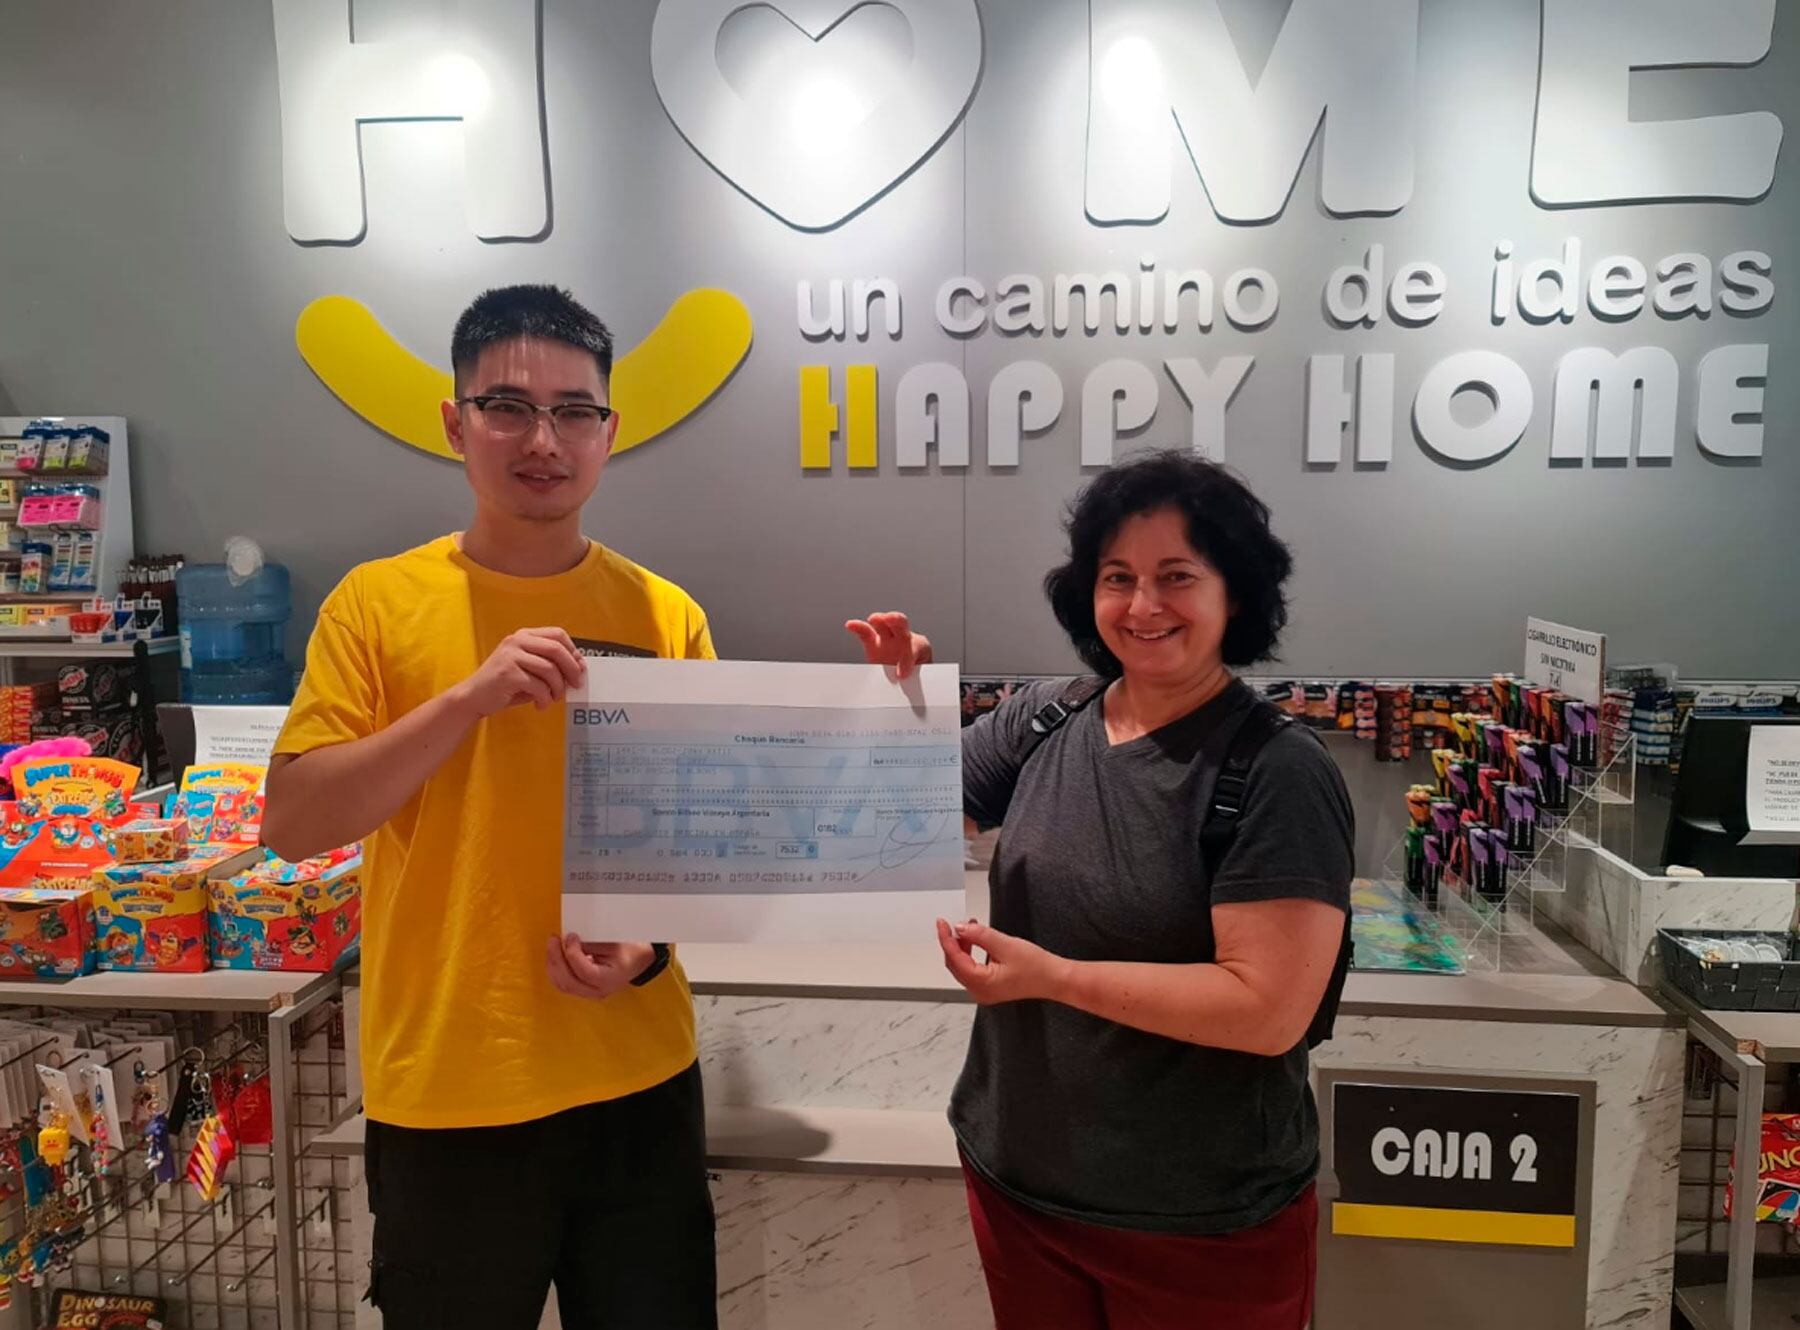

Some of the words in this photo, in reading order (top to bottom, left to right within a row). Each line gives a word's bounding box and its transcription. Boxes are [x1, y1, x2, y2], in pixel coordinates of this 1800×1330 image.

[797, 276, 902, 340] un
[935, 255, 1279, 337] camino
[1326, 244, 1447, 326] de
[1492, 237, 1776, 325] ideas
[799, 354, 1256, 470] HAPPY
[1304, 343, 1770, 466] HOME
[573, 708, 630, 725] BBVA
[1370, 1126, 1493, 1181] CAJA
[1508, 1133, 1539, 1183] 2
[57, 1311, 98, 1328] EGG
